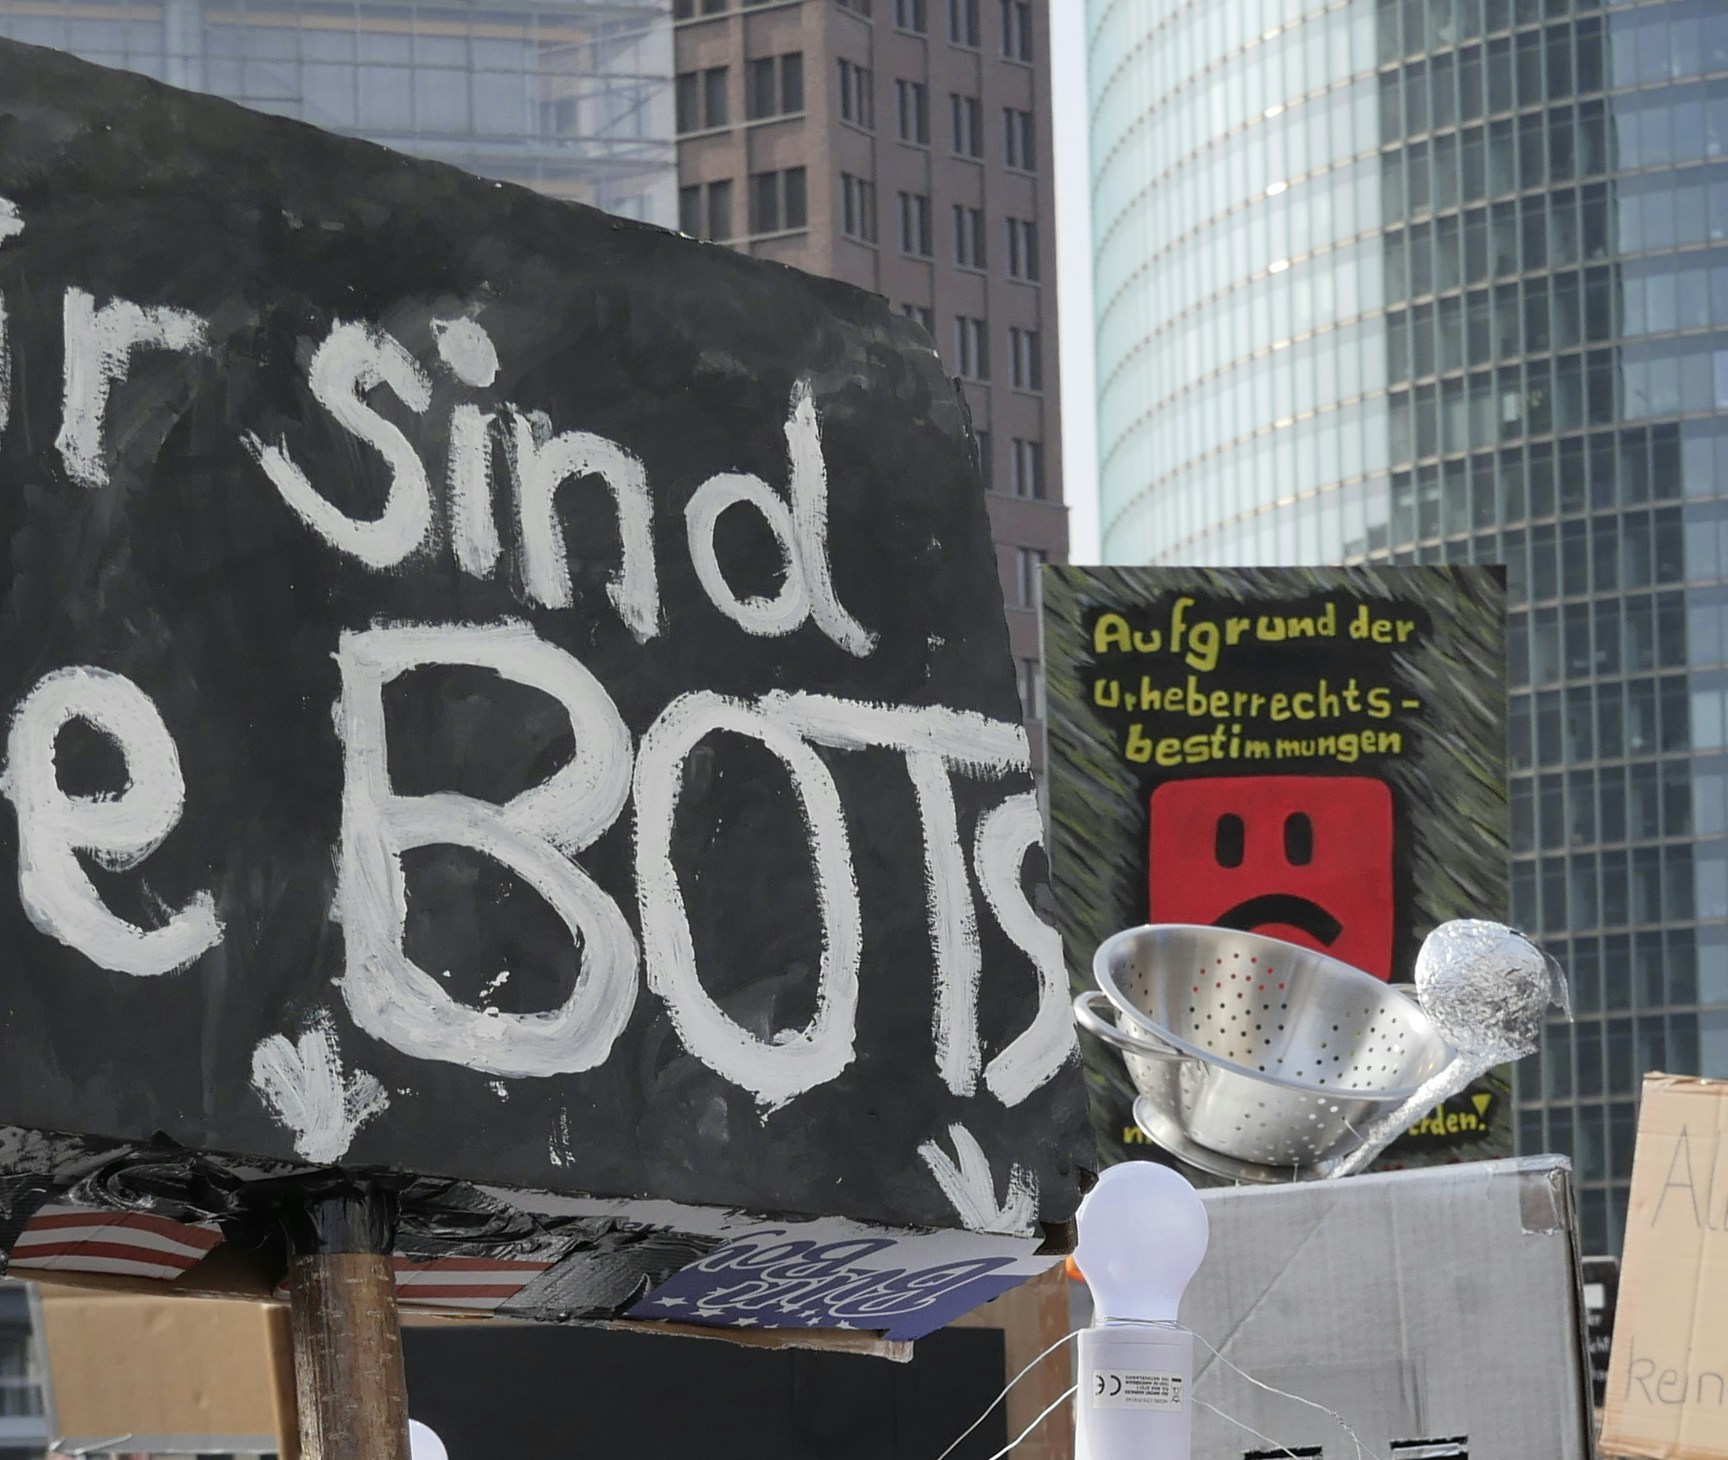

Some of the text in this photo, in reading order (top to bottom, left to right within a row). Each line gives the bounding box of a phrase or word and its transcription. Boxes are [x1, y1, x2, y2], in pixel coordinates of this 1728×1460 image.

[1093, 598, 1416, 671] Aufgrund der
[1126, 725, 1403, 766] bestimmungen
[330, 615, 1079, 1118] BOTS
